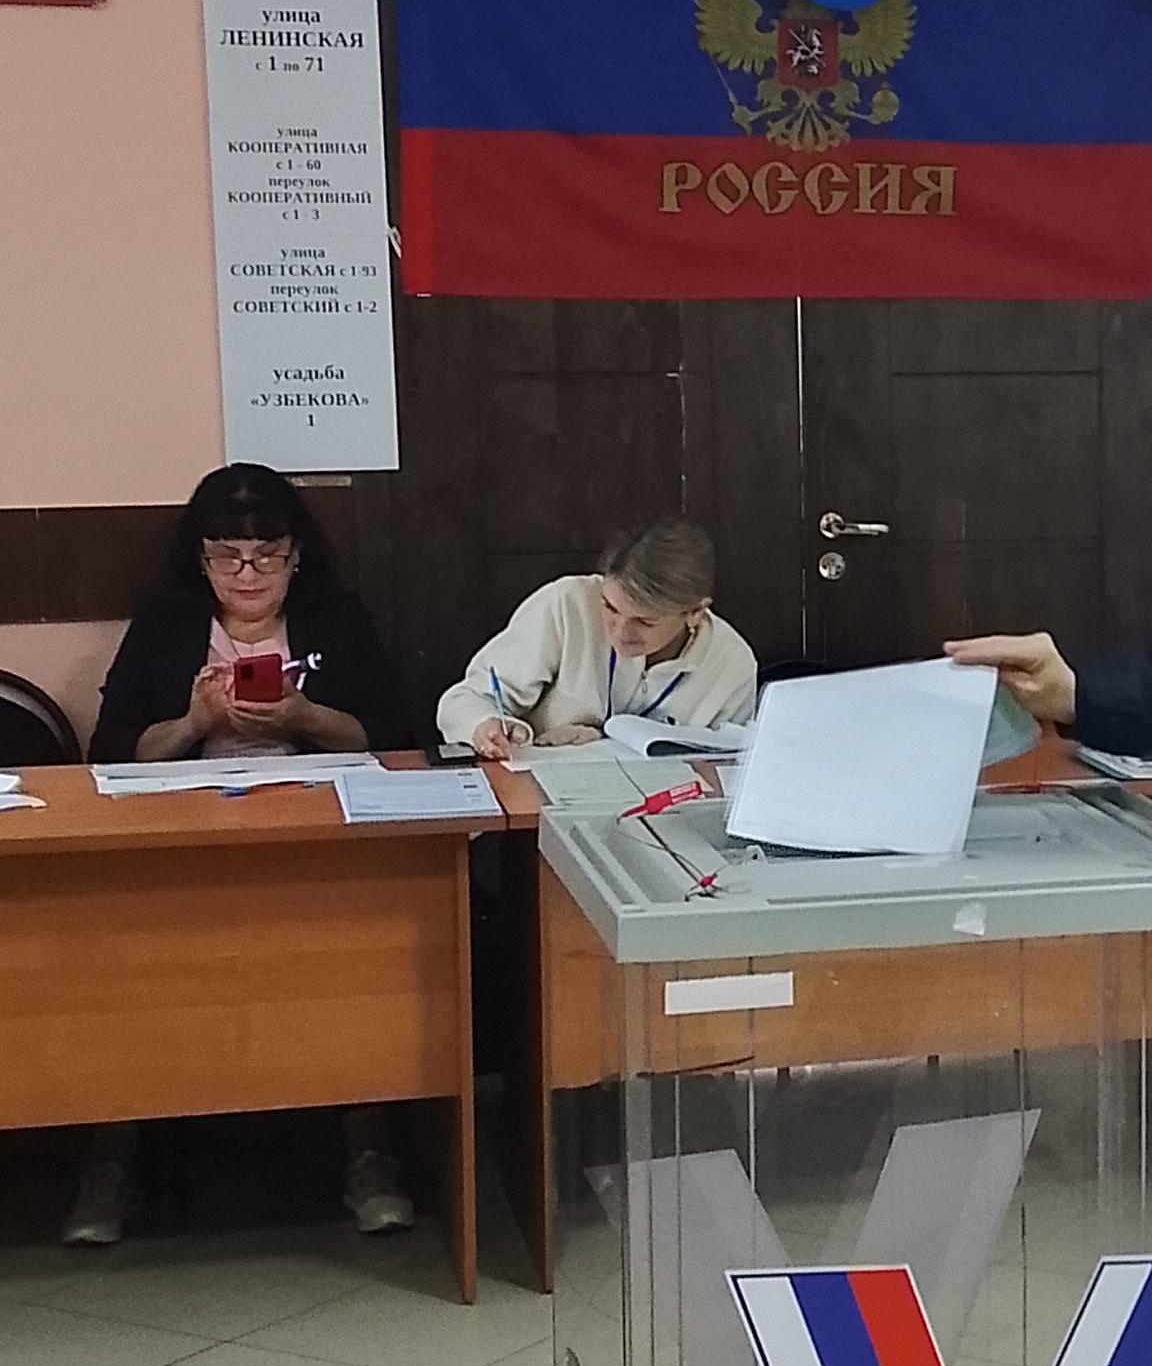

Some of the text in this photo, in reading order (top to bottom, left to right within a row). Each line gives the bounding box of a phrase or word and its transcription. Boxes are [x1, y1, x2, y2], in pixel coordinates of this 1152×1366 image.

[261, 9, 321, 24] улица
[220, 30, 364, 48] ЛЕНИНСКАЯ
[255, 55, 325, 72] с 1 по 71
[277, 128, 318, 139] улица
[228, 141, 368, 154] КООПЕРАТИВНАЯ
[276, 161, 283, 170] с
[287, 159, 293, 170] 1
[306, 159, 321, 170] 60
[268, 177, 331, 189] переулок
[658, 161, 959, 216] РОССИЯ
[228, 190, 372, 204] КООПЕРАТИВНЫЙ
[282, 211, 289, 220] с
[293, 209, 299, 220] 1
[312, 209, 320, 220] 3
[280, 248, 326, 261] улица
[230, 263, 335, 277] СОВЕТСКАЯ
[339, 268, 347, 277] с
[270, 284, 339, 297] переулок
[233, 298, 378, 313] СОВЕТСКИЙ с 1-2
[273, 365, 345, 383] усадьба
[251, 391, 369, 408] «УЗБЕКОВА»
[307, 414, 315, 427] 1
